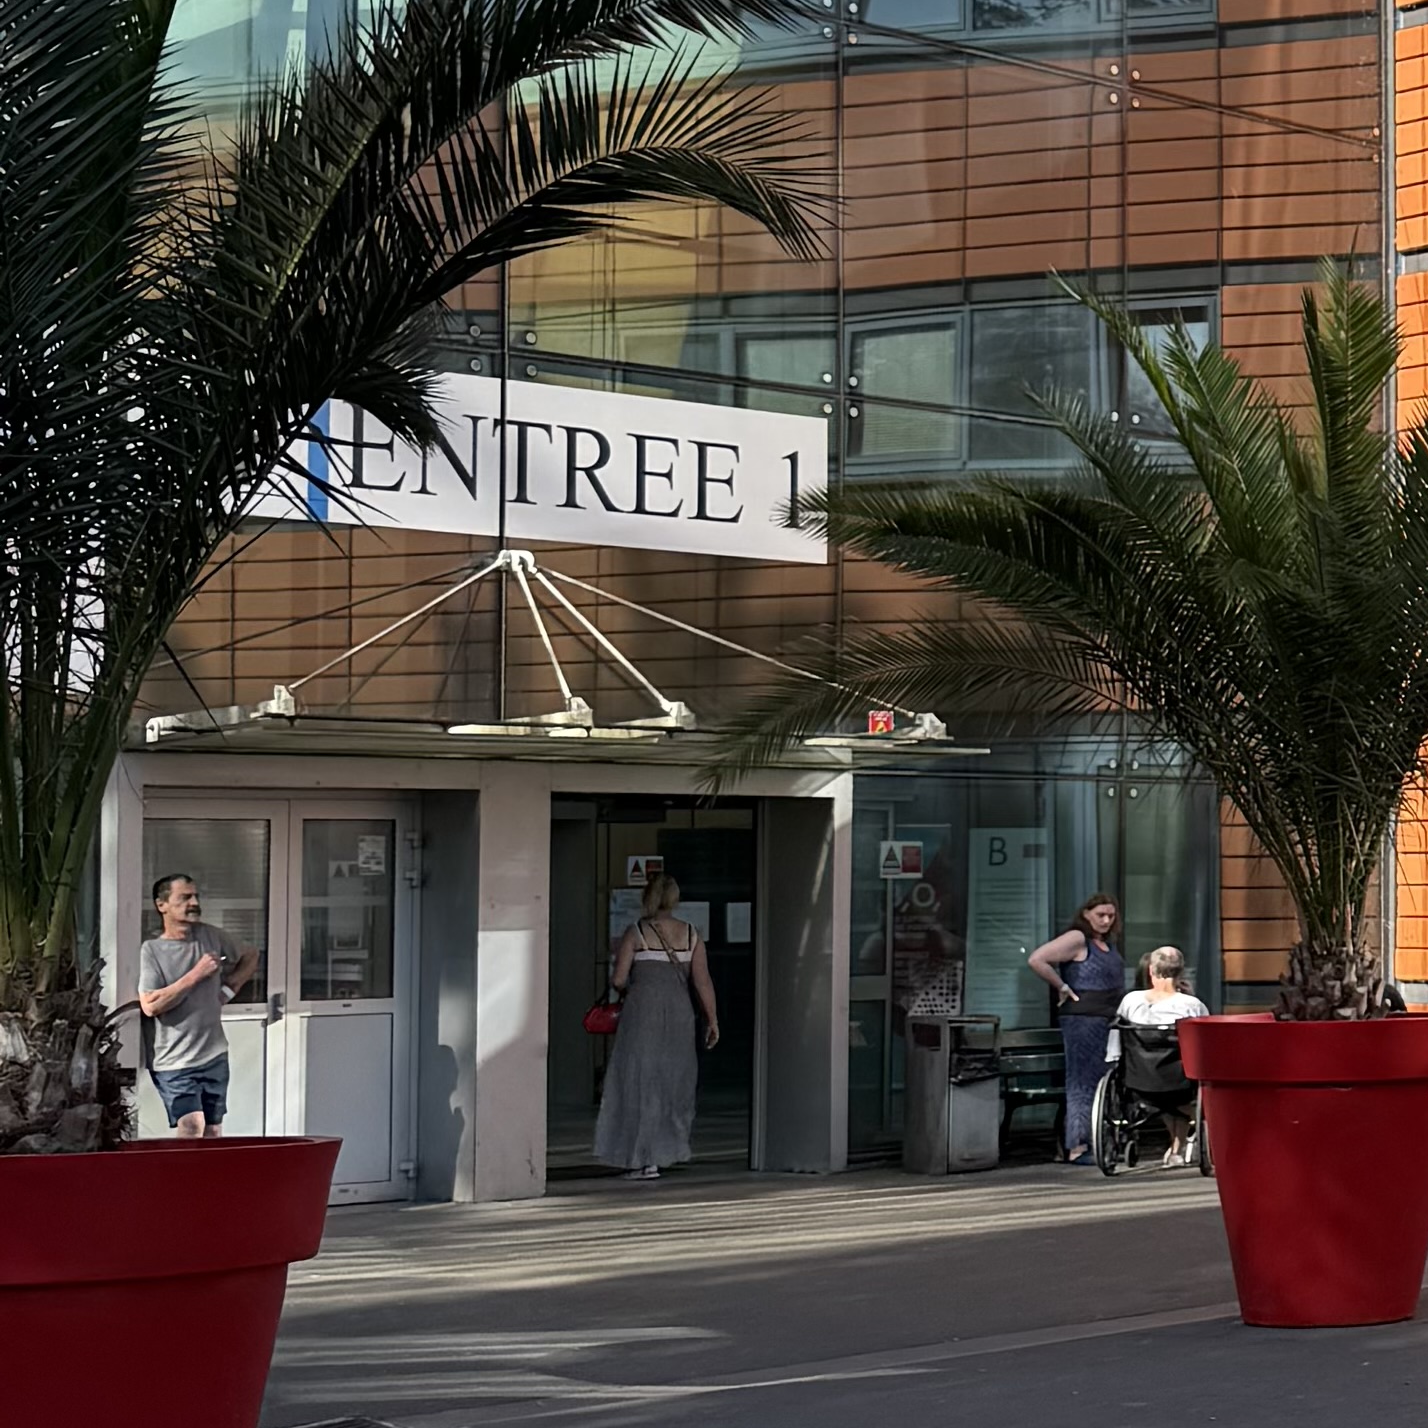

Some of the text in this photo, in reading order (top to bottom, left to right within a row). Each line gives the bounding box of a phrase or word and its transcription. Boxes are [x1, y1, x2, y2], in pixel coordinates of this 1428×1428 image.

[341, 400, 805, 529] ENTREE 1
[988, 836, 1008, 866] B
